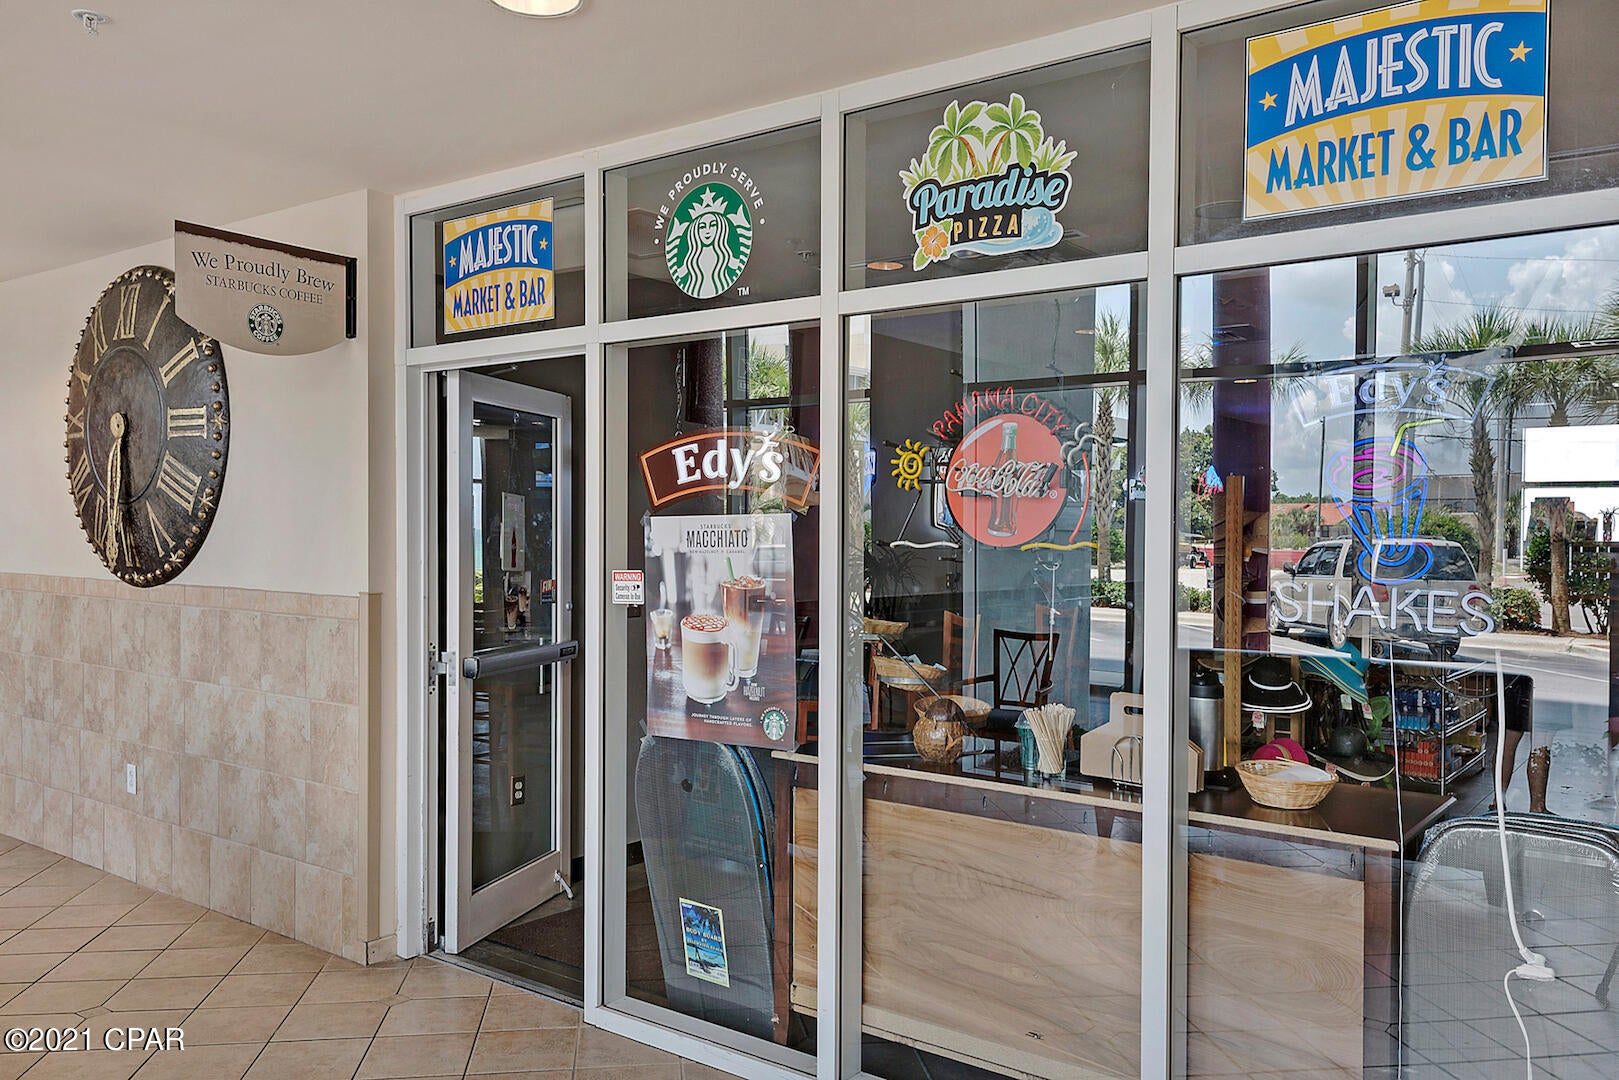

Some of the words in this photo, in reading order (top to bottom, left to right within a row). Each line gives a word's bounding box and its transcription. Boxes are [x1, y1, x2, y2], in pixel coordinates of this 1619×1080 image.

[1284, 21, 1504, 128] MAJESTIC
[1265, 128, 1395, 194] MARKET
[1405, 123, 1436, 171] &
[1448, 108, 1522, 166] BAR
[655, 205, 670, 230] WE
[668, 162, 727, 201] PROUDLY
[730, 167, 764, 209] SERVE
[913, 167, 1065, 225] Paradise
[458, 224, 539, 279] MAJESTIC
[953, 214, 1018, 242] PIZZA
[191, 251, 218, 269] We
[224, 254, 290, 283] Proudly
[296, 268, 335, 292] Brew
[206, 274, 277, 297] STARBUCKS
[279, 287, 323, 305] COFFEE
[737, 287, 750, 296] TM
[453, 284, 501, 319] MARKET
[504, 282, 516, 311] &
[519, 277, 546, 308] BAR
[1324, 362, 1450, 410] Edy's
[932, 386, 1015, 440] PANAMA
[1020, 393, 1071, 435] CITY
[672, 430, 783, 490] Edy's
[686, 530, 748, 548] MACCHIATO
[614, 572, 641, 581] WARNING
[1274, 581, 1496, 636] SHAKES
